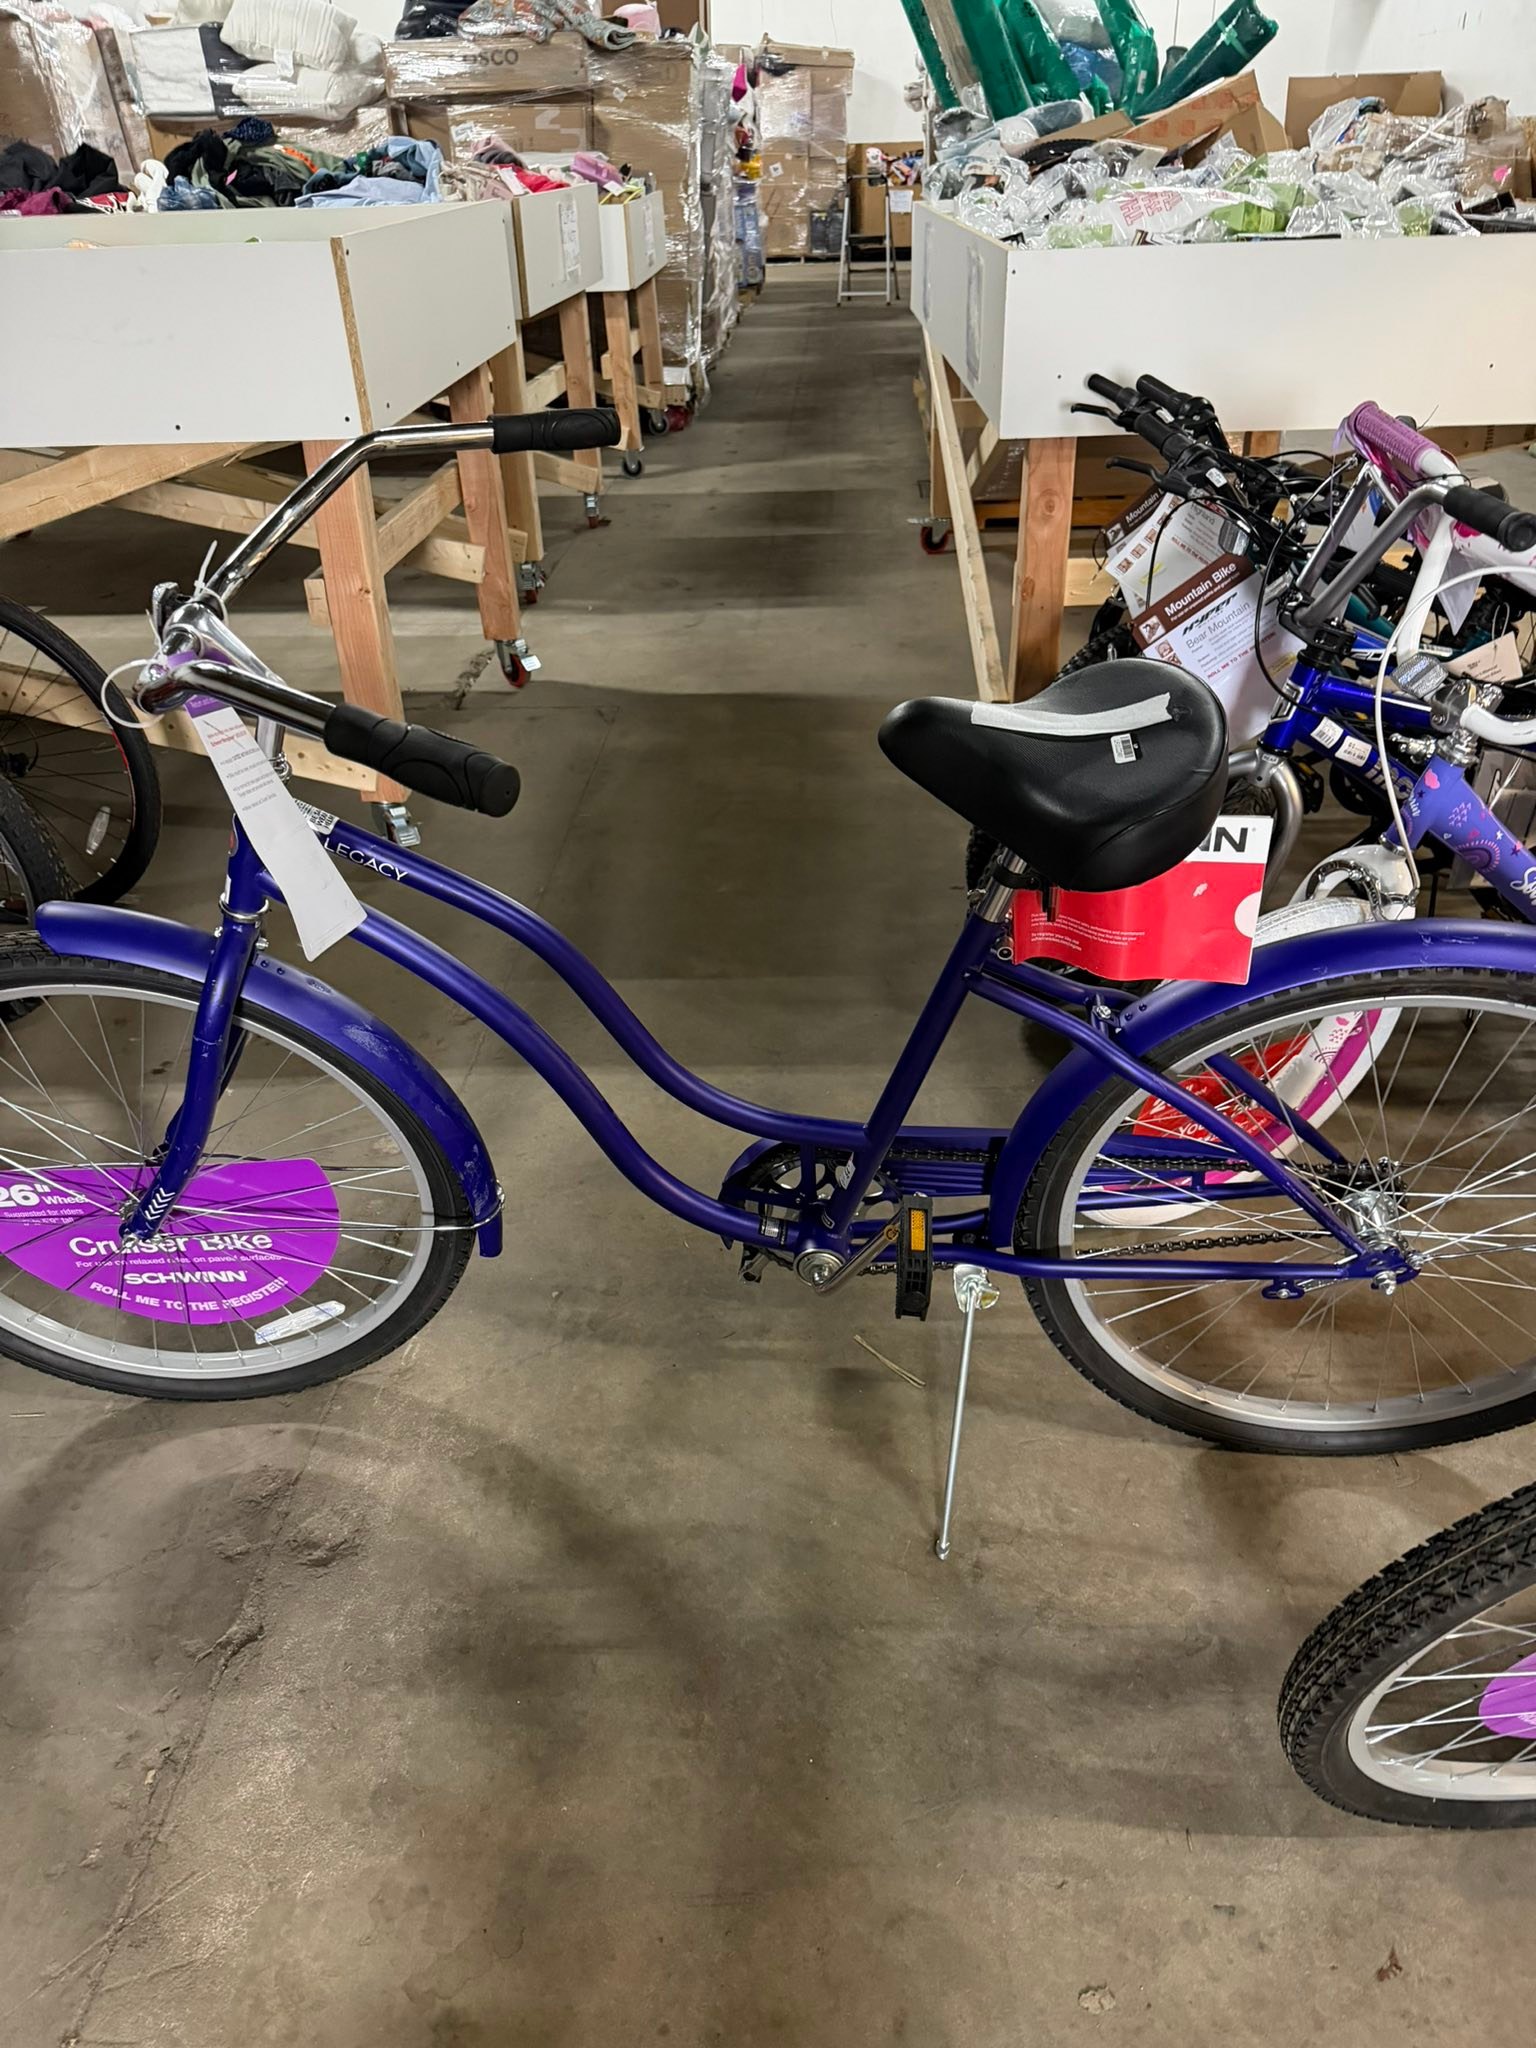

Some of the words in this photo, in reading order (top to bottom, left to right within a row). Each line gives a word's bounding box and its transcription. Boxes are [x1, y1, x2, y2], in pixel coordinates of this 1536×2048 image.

[1125, 492, 1159, 523] Mountain
[1164, 579, 1212, 617] Mountain
[1212, 562, 1237, 584] Bike
[1186, 631, 1208, 649] Bear
[1208, 602, 1251, 635] Mountain
[324, 837, 408, 880] LEGACY
[200, 1234, 273, 1251] Bike
[129, 1257, 165, 1265] relaxed
[193, 1255, 206, 1263] on
[124, 1270, 247, 1285] SCHWINN
[90, 1281, 131, 1301] ROLL
[135, 1294, 160, 1307] ME
[163, 1300, 185, 1311] TO
[188, 1300, 220, 1311] THE
